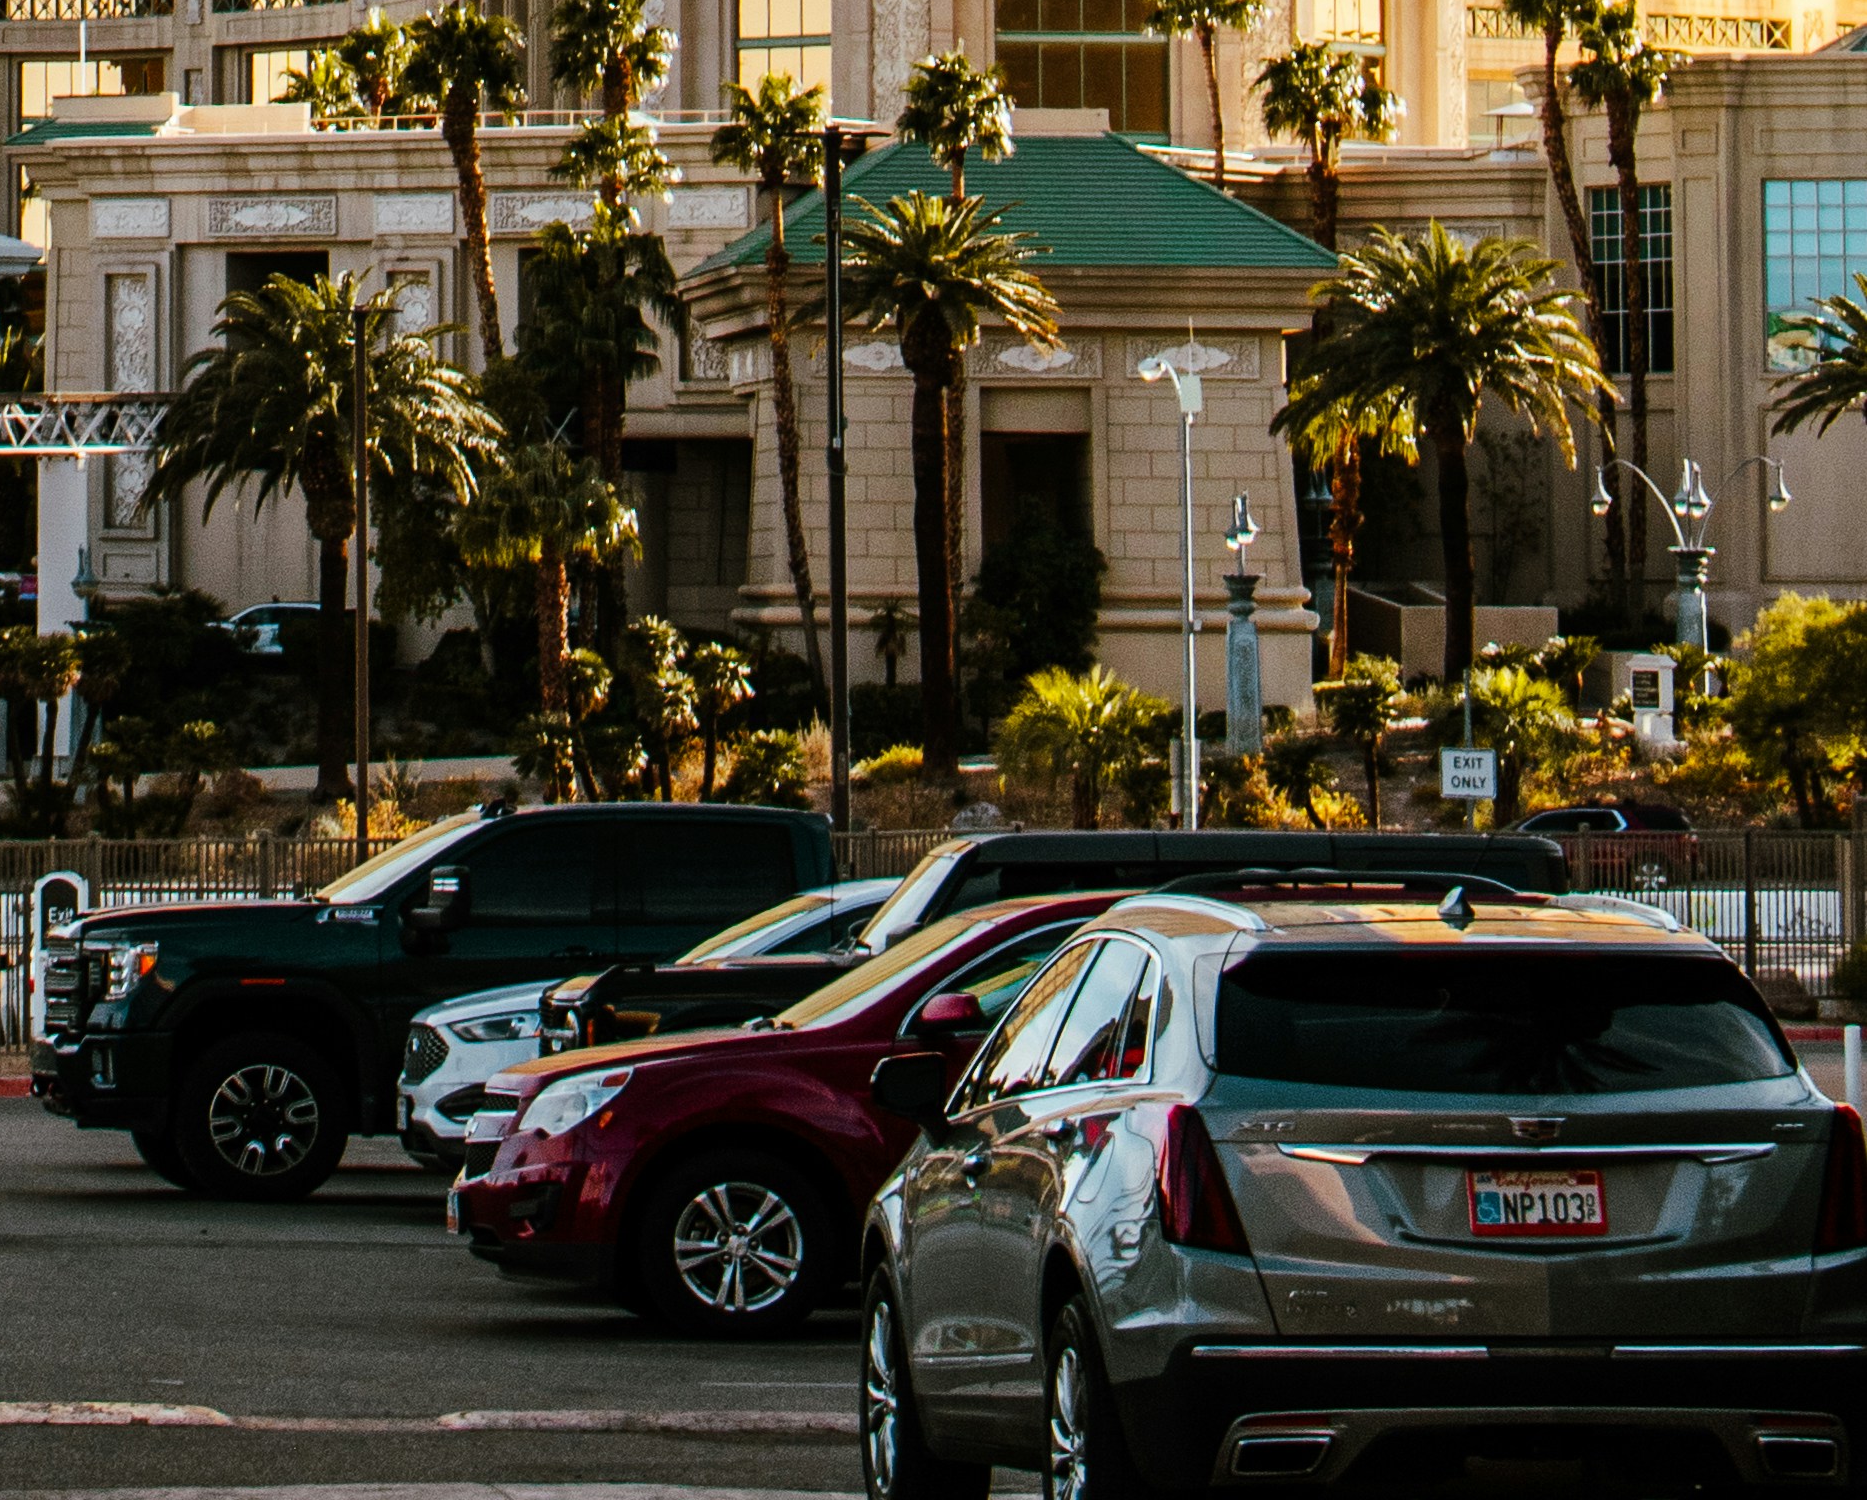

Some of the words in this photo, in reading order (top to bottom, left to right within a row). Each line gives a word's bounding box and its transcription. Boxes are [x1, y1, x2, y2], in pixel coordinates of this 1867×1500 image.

[1453, 756, 1484, 769] EXIT
[1451, 775, 1487, 789] ONLY
[1502, 1192, 1584, 1223] NP103
